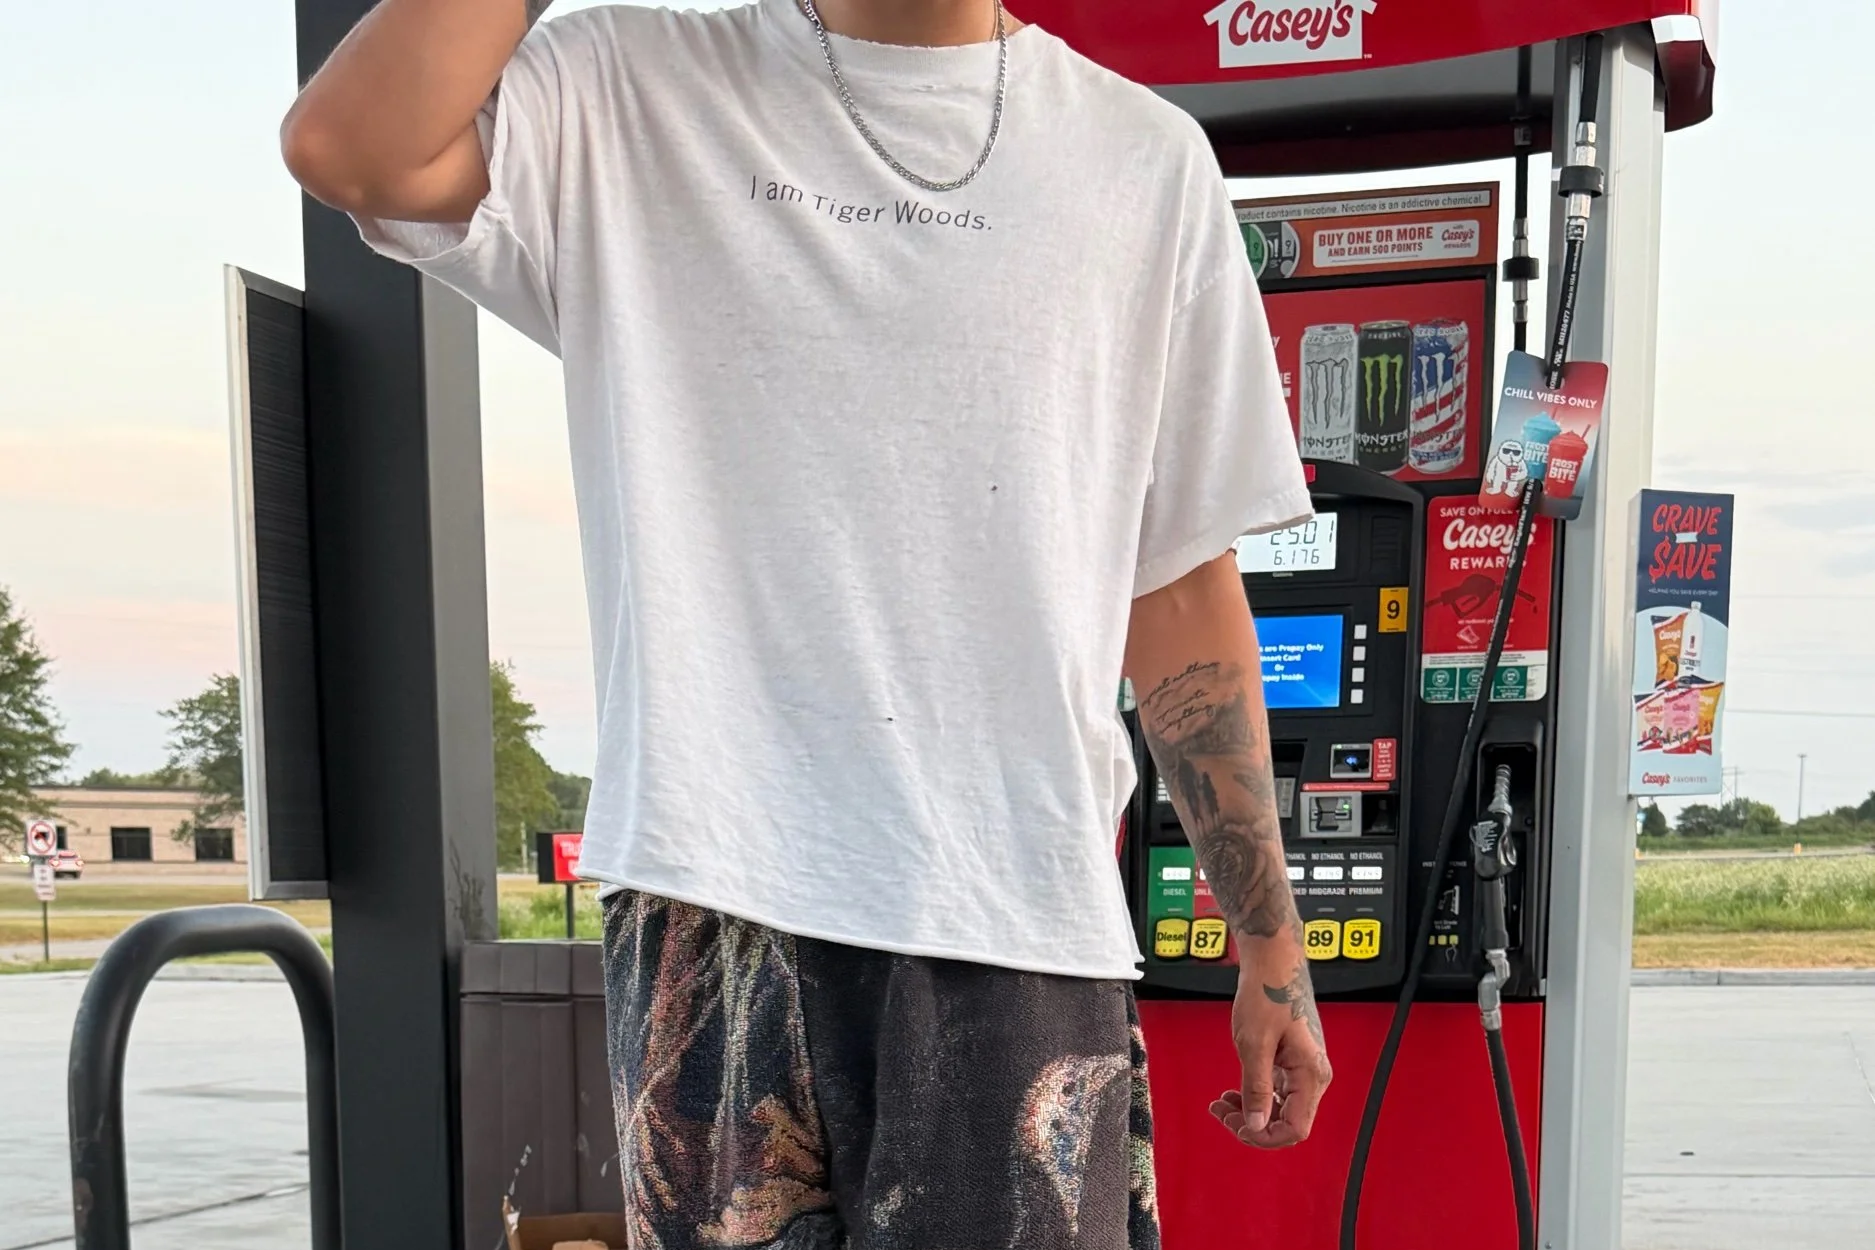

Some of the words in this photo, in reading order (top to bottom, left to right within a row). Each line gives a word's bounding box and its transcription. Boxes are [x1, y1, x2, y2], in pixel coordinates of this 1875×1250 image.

[1228, 0, 1354, 51] Casey's
[750, 174, 757, 200] I
[766, 181, 803, 203] am
[812, 194, 887, 224] Tiger
[894, 200, 994, 231] Woods.
[1237, 211, 1265, 221] roduct
[1266, 208, 1302, 219] contains
[1341, 202, 1377, 213] Nicotine
[1379, 202, 1386, 210] is
[1387, 201, 1399, 210] an
[1400, 198, 1440, 209] addictive
[1318, 233, 1343, 247] BUY
[1347, 230, 1374, 245] ONE
[1376, 229, 1393, 243] OR
[1396, 226, 1434, 241] MORE
[1328, 247, 1345, 257] AND
[1347, 246, 1370, 256] EARN
[1372, 244, 1389, 255] 500
[1391, 242, 1423, 253] POINTS
[1504, 387, 1534, 401] CHILL
[1536, 391, 1567, 405] VIBES
[1568, 397, 1598, 409] ONLY
[1354, 429, 1408, 446] MONSTER
[1551, 458, 1578, 470] FROST
[1549, 468, 1576, 482] BITE
[1440, 506, 1466, 518] SAVE
[1468, 506, 1484, 516] ON
[1652, 503, 1722, 535] CRAVE
[1273, 548, 1320, 566] 6.176
[1386, 599, 1400, 620] 9
[1306, 643, 1324, 652] Only
[1283, 654, 1302, 662] Card
[1274, 663, 1285, 672] Or
[1281, 673, 1305, 681] Inside
[1378, 742, 1392, 750] TAP
[1641, 771, 1671, 787] Casey's
[1673, 775, 1708, 784] FAVORITES
[1311, 852, 1319, 861] NO
[1320, 852, 1345, 861] ETHANOL
[1349, 852, 1358, 860] NO
[1358, 851, 1384, 860] ETHANOL
[1163, 888, 1187, 897] DIESEL
[1308, 887, 1347, 896] MIDGRADE
[1348, 887, 1384, 896] PREMIUM
[1156, 931, 1187, 942] Diesel
[1194, 930, 1222, 949] 87
[1307, 929, 1334, 948] 89
[1350, 929, 1374, 948] 91
